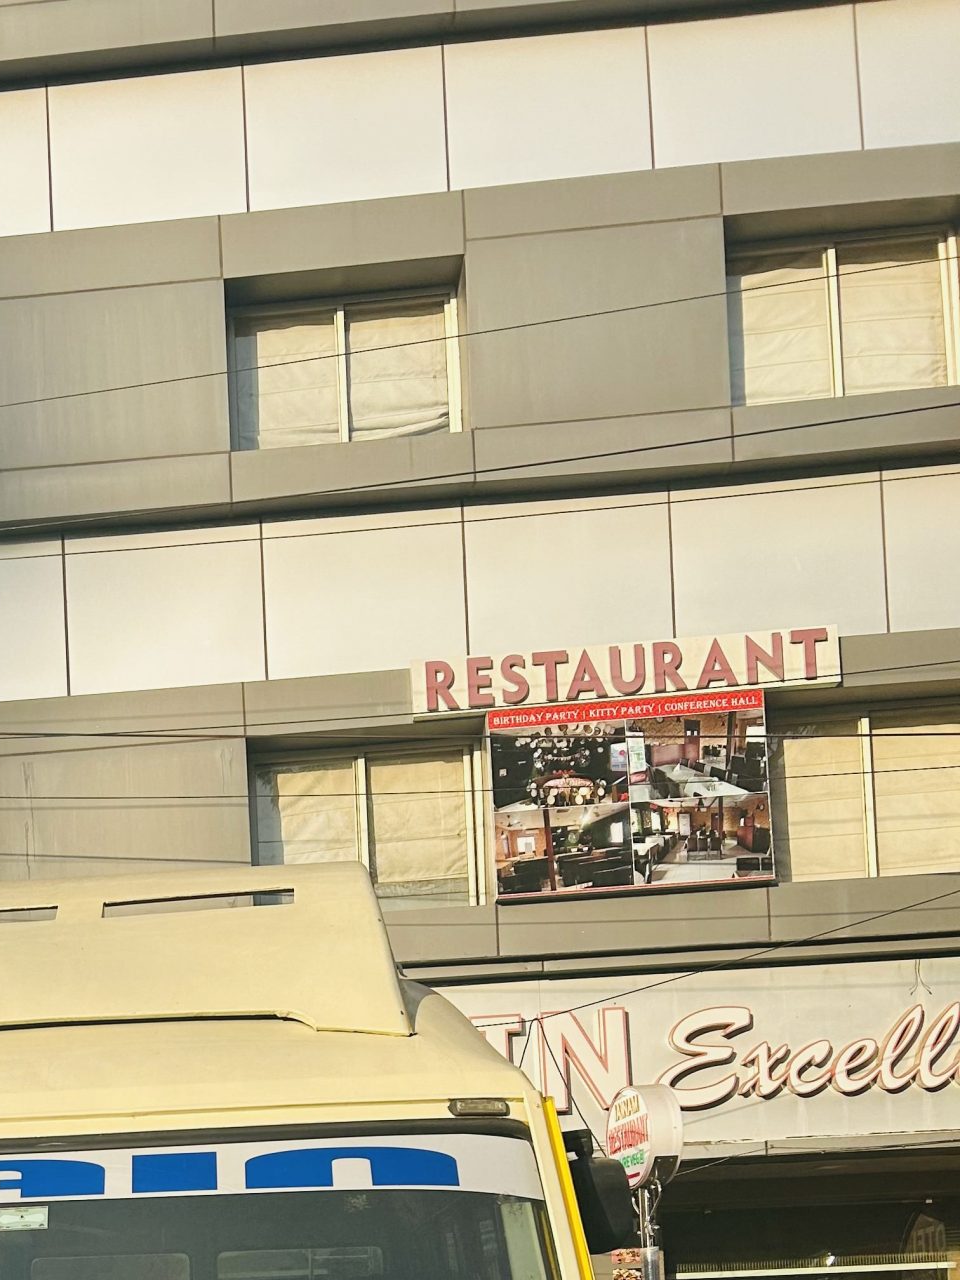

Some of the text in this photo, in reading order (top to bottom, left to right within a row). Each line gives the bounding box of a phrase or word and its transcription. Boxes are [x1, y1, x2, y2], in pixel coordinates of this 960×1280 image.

[424, 627, 829, 713] RESTAURANT
[493, 695, 759, 726] BIRTHDAY PARTY KITTY PARTY CONFERENCE HALL
[651, 1003, 960, 1112] Excell
